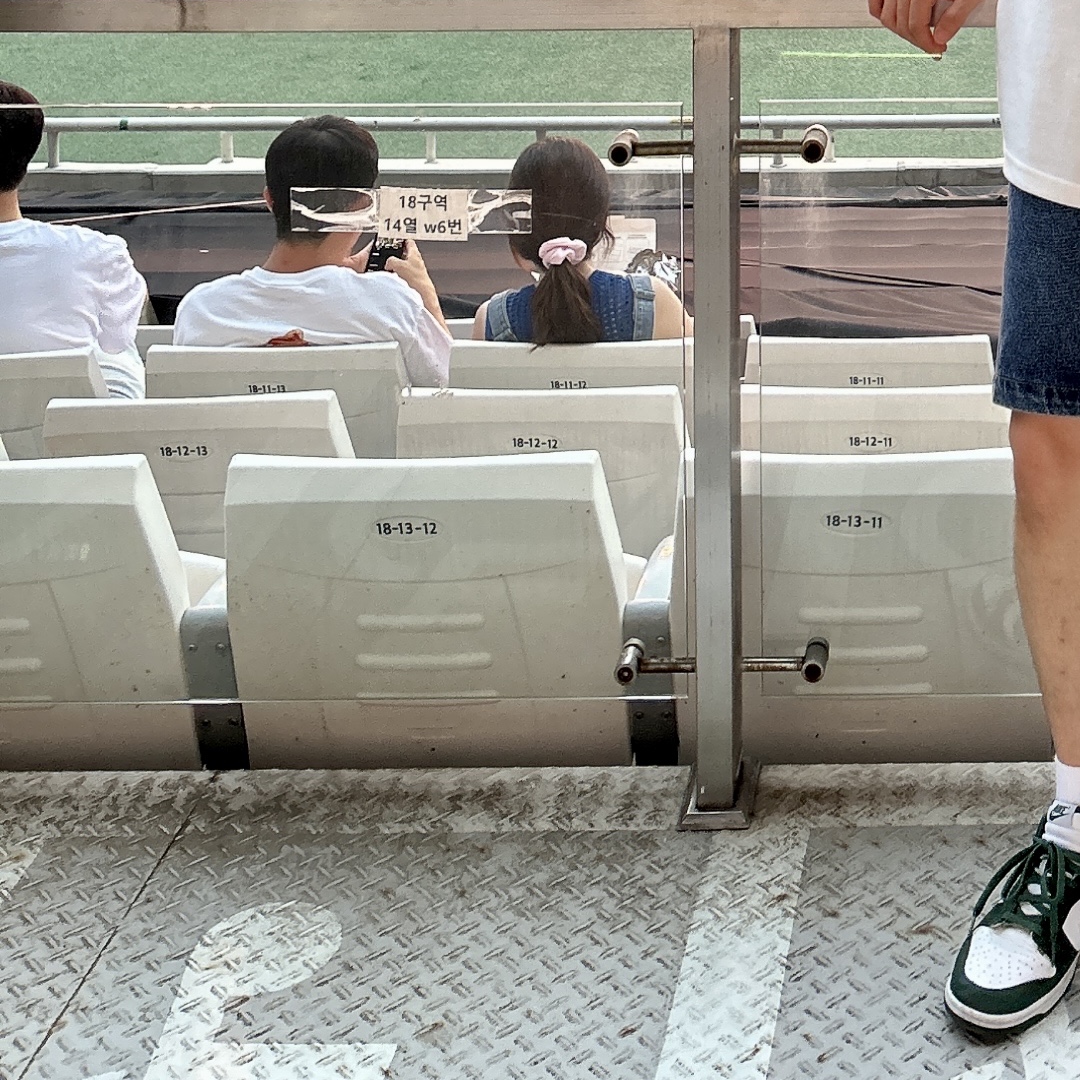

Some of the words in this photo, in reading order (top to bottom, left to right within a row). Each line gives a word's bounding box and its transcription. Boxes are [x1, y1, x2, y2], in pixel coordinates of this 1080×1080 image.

[399, 194, 448, 211] 18구역
[384, 217, 418, 234] 14열
[424, 218, 462, 235] w6번
[550, 380, 587, 389] 18-11-12
[849, 376, 884, 385] 18-11-11
[248, 385, 286, 393] 18-11-13
[512, 438, 558, 449] 18-12-12
[849, 437, 892, 447] 18-12-11
[159, 446, 208, 456] 18-12-13
[826, 515, 883, 528] 18-13-11
[376, 522, 437, 535] 18-13-12
